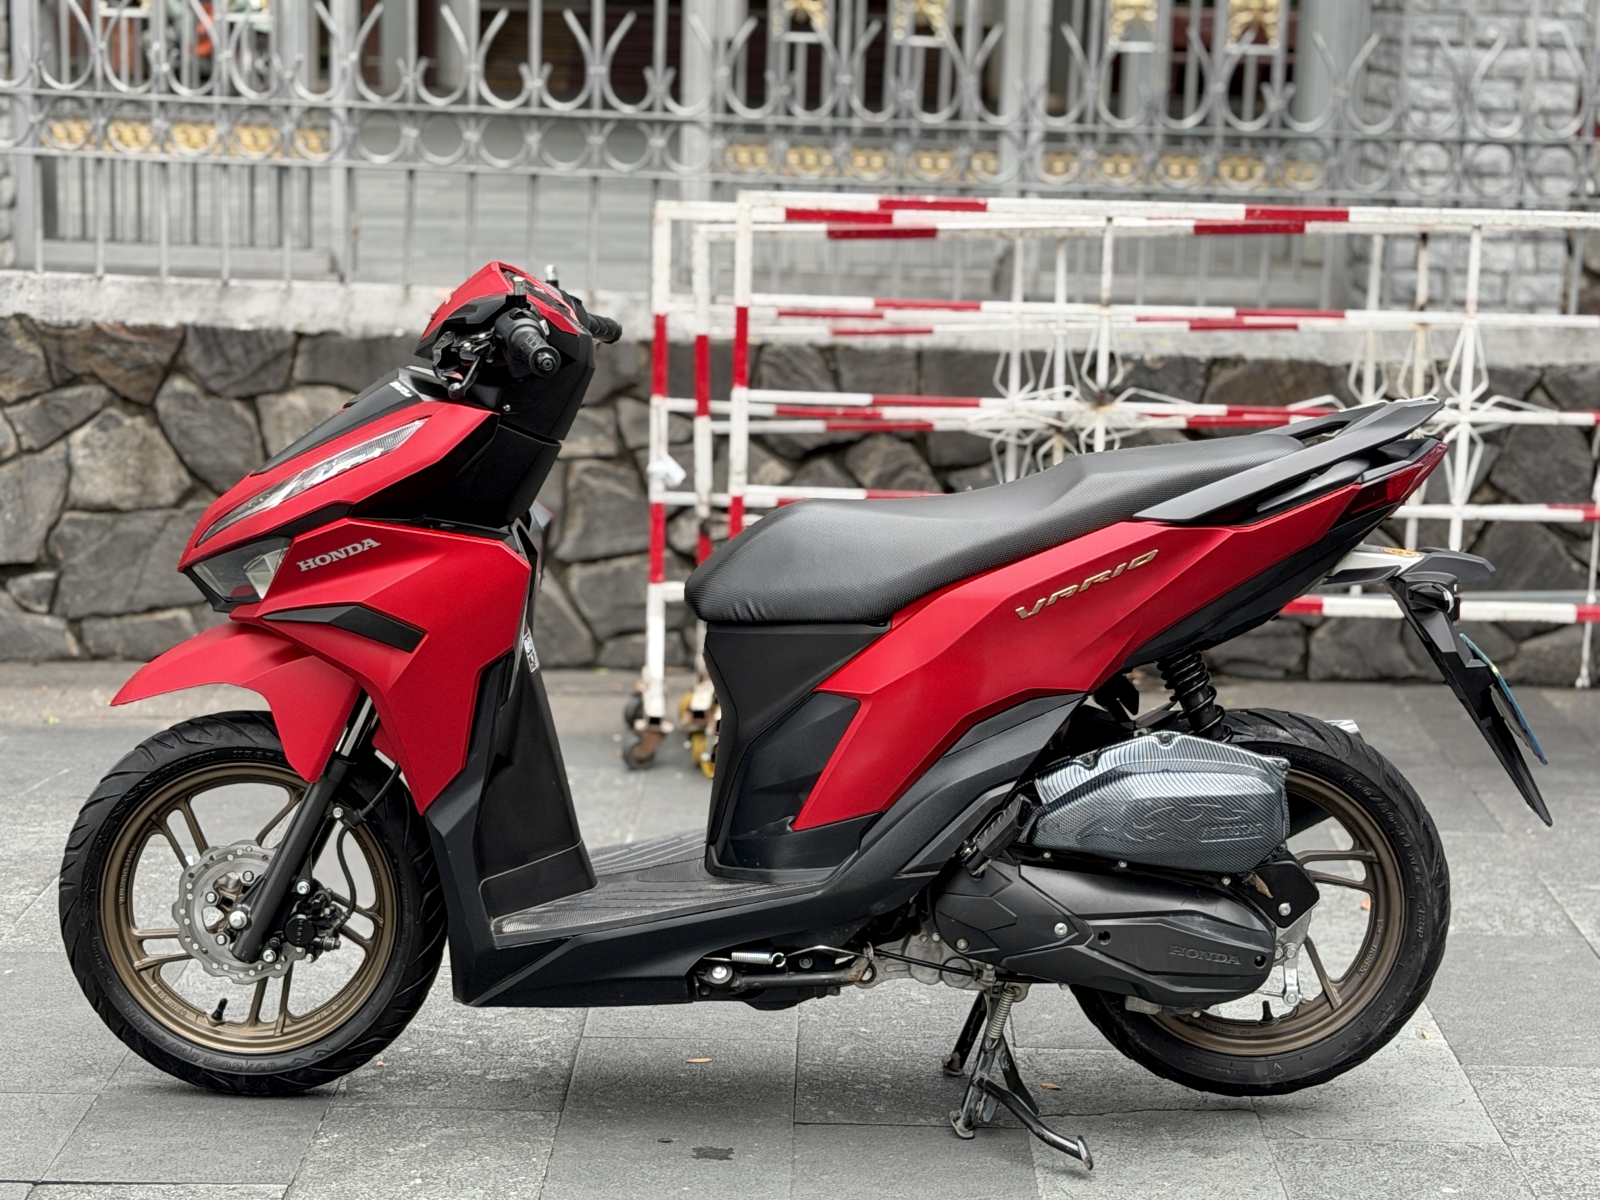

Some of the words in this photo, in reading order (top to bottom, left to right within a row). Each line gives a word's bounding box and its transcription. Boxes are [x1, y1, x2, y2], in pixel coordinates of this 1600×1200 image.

[296, 538, 382, 571] HONDA
[1015, 549, 1159, 620] VARIO
[1169, 945, 1241, 966] HONDA
